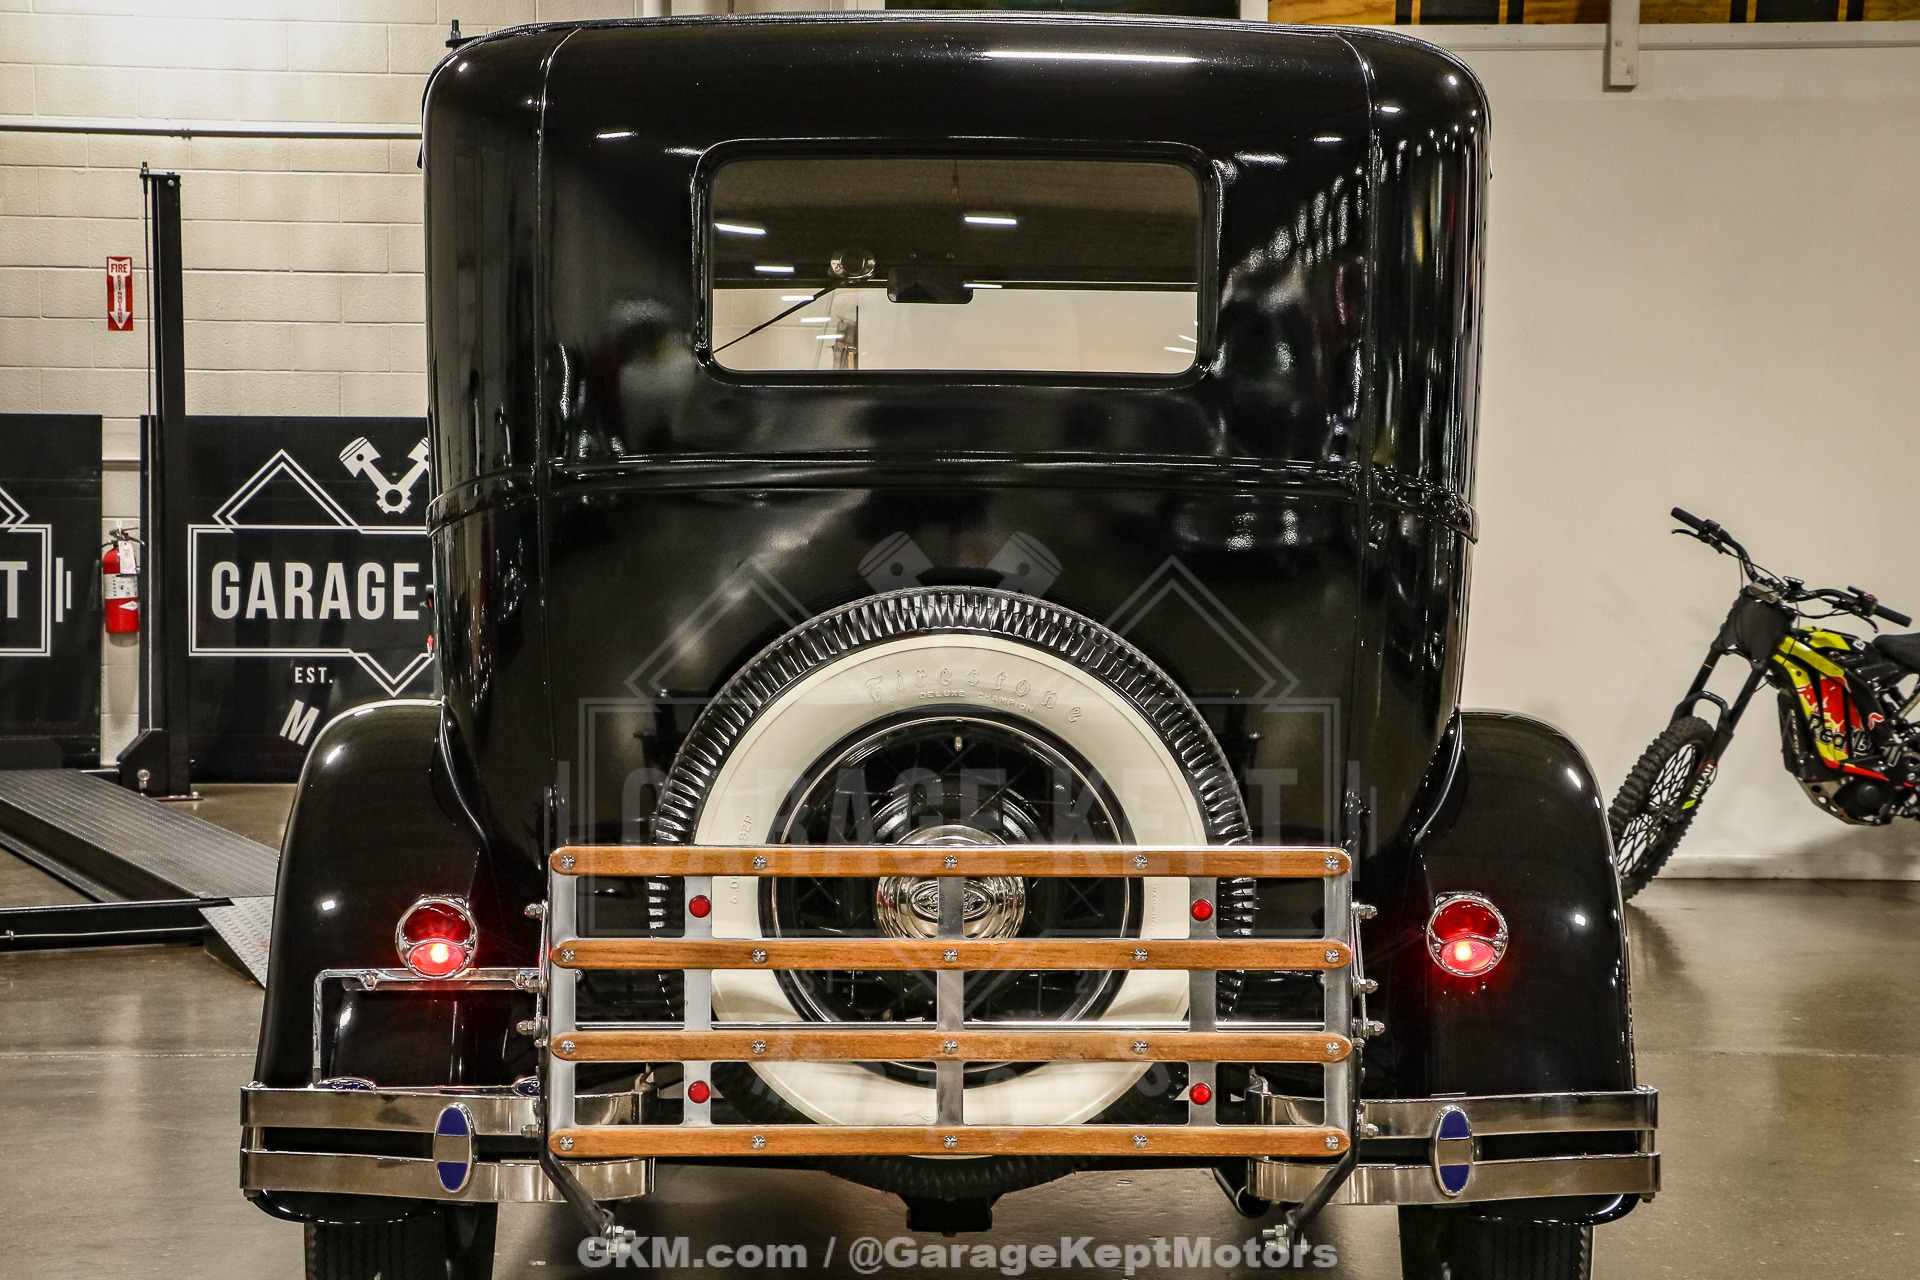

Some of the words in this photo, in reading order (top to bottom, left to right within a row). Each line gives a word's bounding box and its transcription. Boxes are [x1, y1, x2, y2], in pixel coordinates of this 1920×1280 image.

[110, 263, 127, 273] FIRE
[211, 561, 420, 620] GARAGE
[294, 667, 334, 684] EST.
[864, 667, 1082, 722] Firestone
[920, 690, 965, 699] DELUXE
[977, 692, 1034, 713] CHAMPION
[1690, 763, 1714, 799] KILLAH
